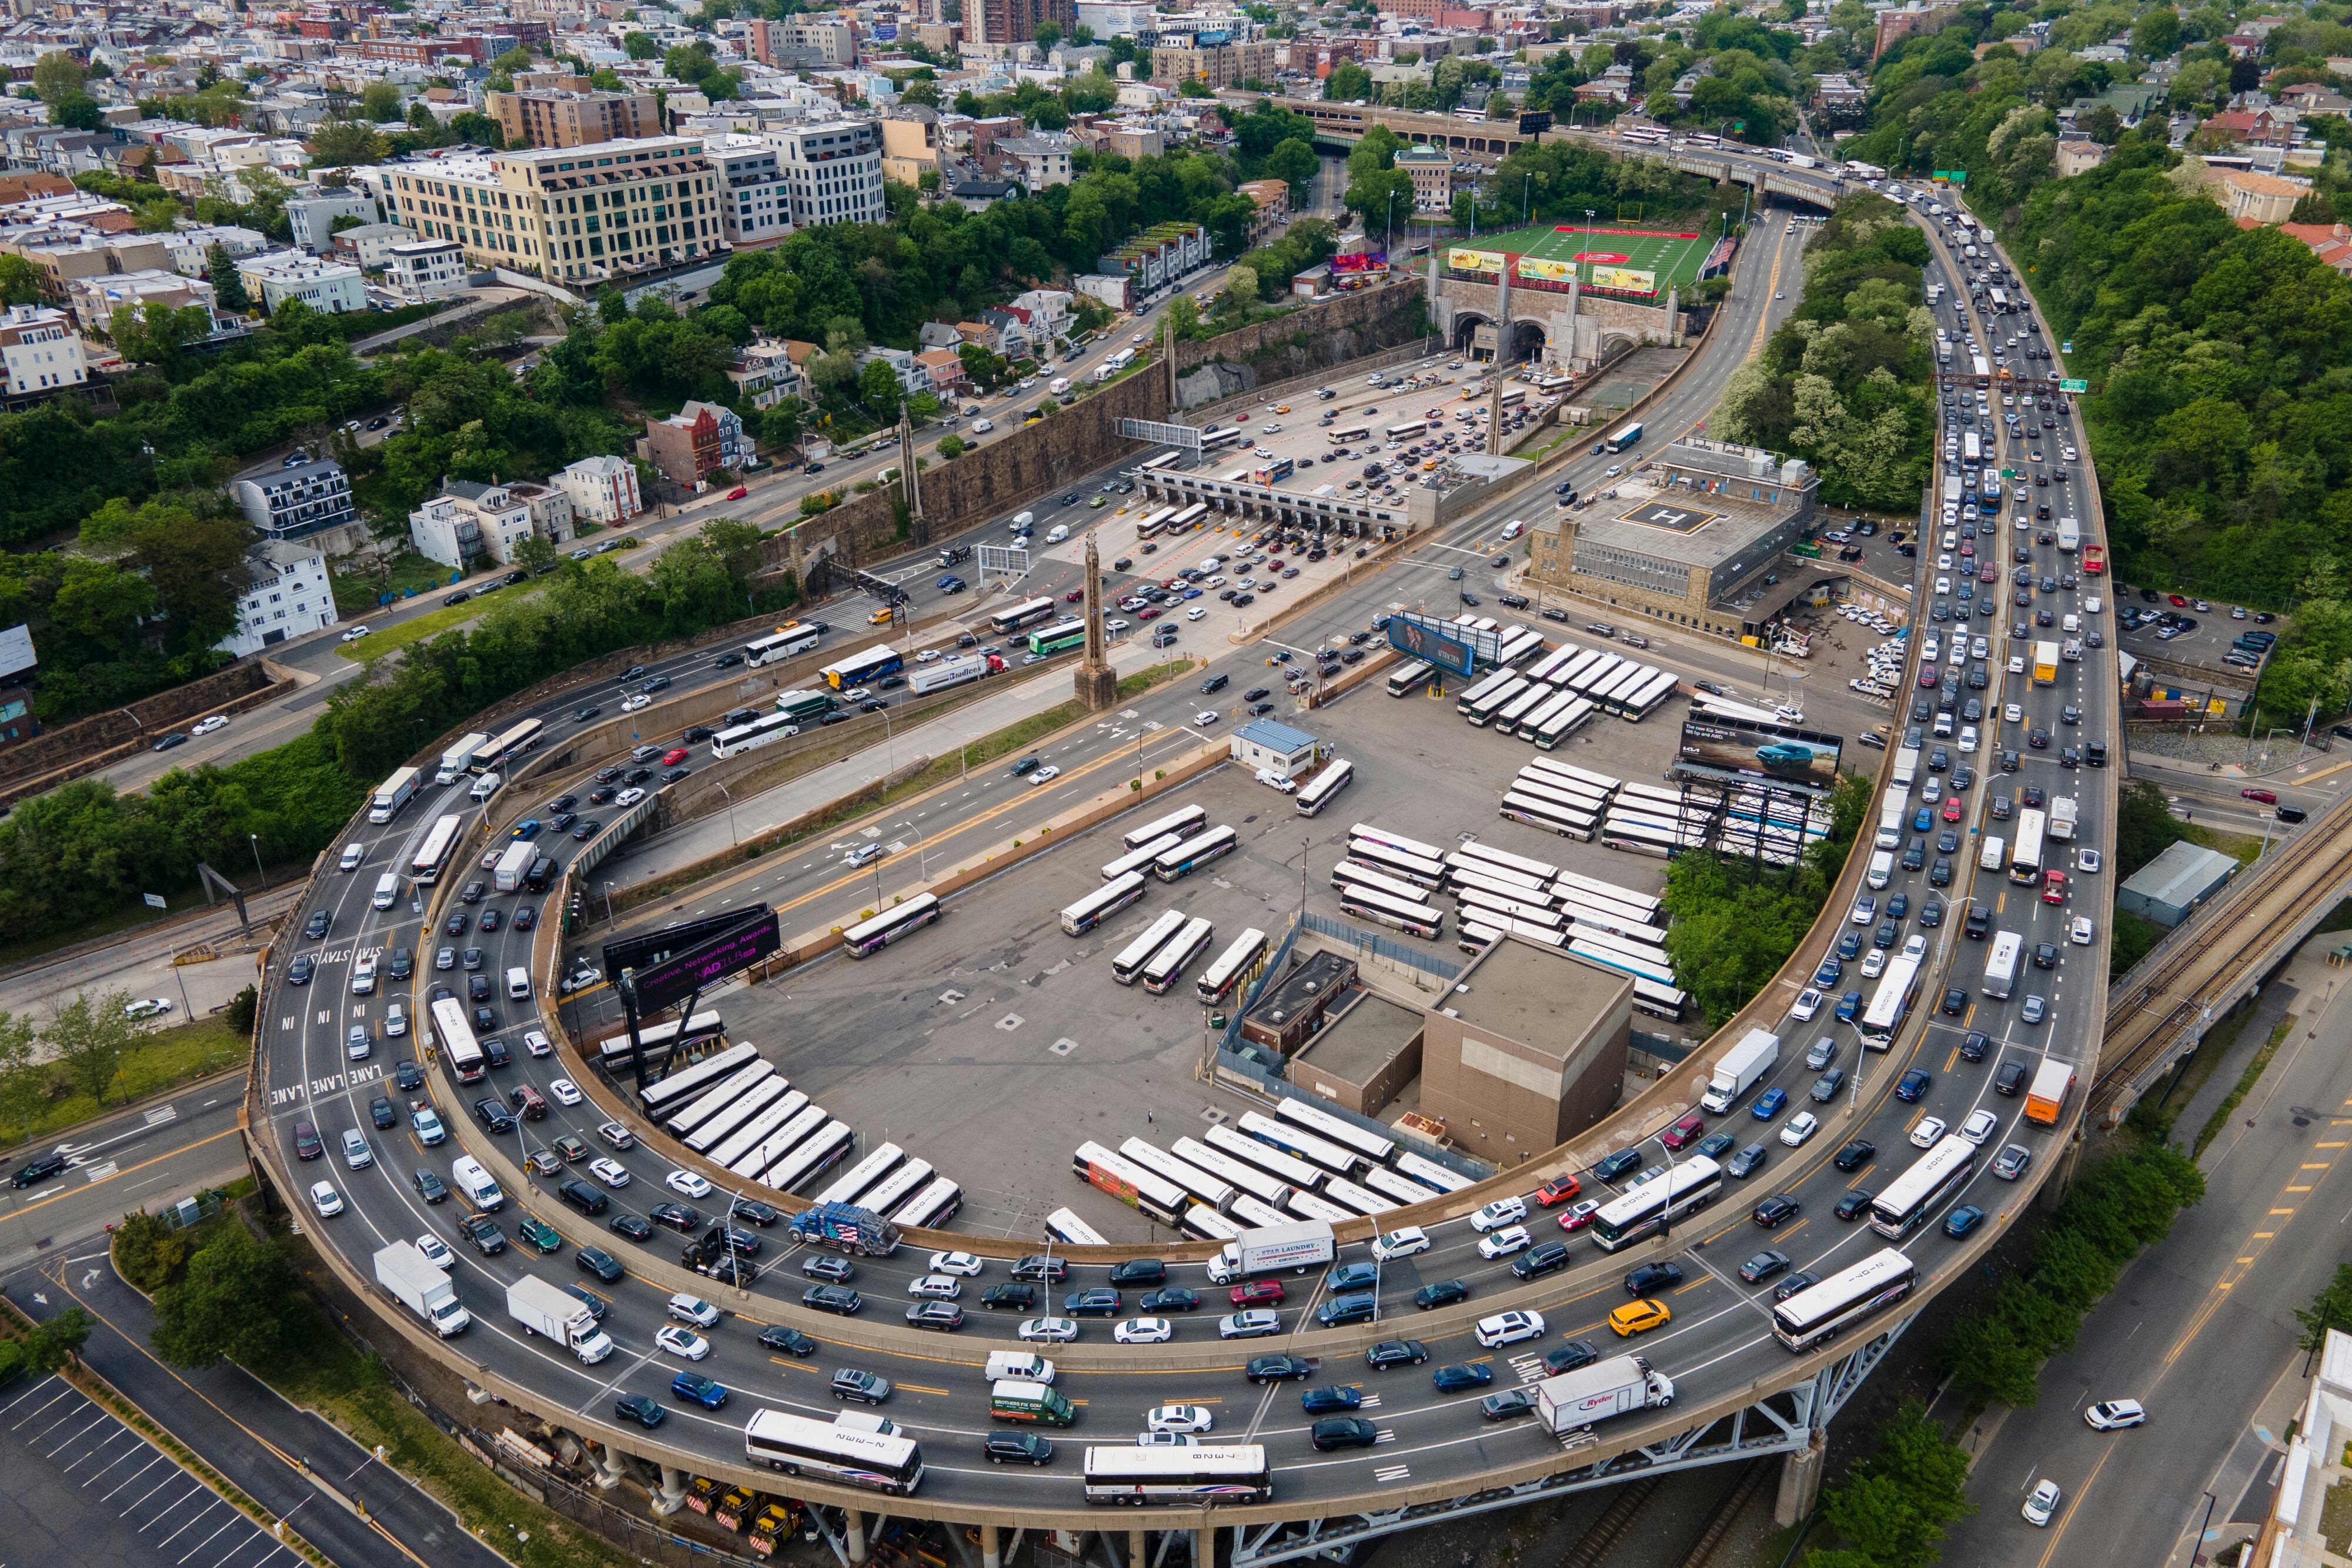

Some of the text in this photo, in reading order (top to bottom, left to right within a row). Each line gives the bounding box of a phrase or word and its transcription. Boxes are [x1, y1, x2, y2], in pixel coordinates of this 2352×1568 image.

[1556, 267, 1575, 275] Yellow
[1631, 276, 1650, 285] Yellow
[1651, 510, 1687, 524] H
[321, 950, 350, 964] STAY
[356, 947, 384, 959] STAY
[644, 967, 683, 988] Creative.
[685, 942, 737, 969] Networking.
[740, 925, 772, 944] Awards.
[289, 954, 318, 968] SY
[318, 1010, 330, 1024] IN
[353, 1004, 365, 1018] IN
[282, 1016, 294, 1030] IN
[349, 1064, 382, 1084] LANE
[311, 1074, 345, 1094] LANE
[271, 1084, 305, 1105] LANE
[1282, 1243, 1315, 1253] LAUNDRY
[1849, 1262, 1884, 1282] 21071
[1588, 1395, 1613, 1407] Ryder
[836, 1434, 884, 1447] 21332
